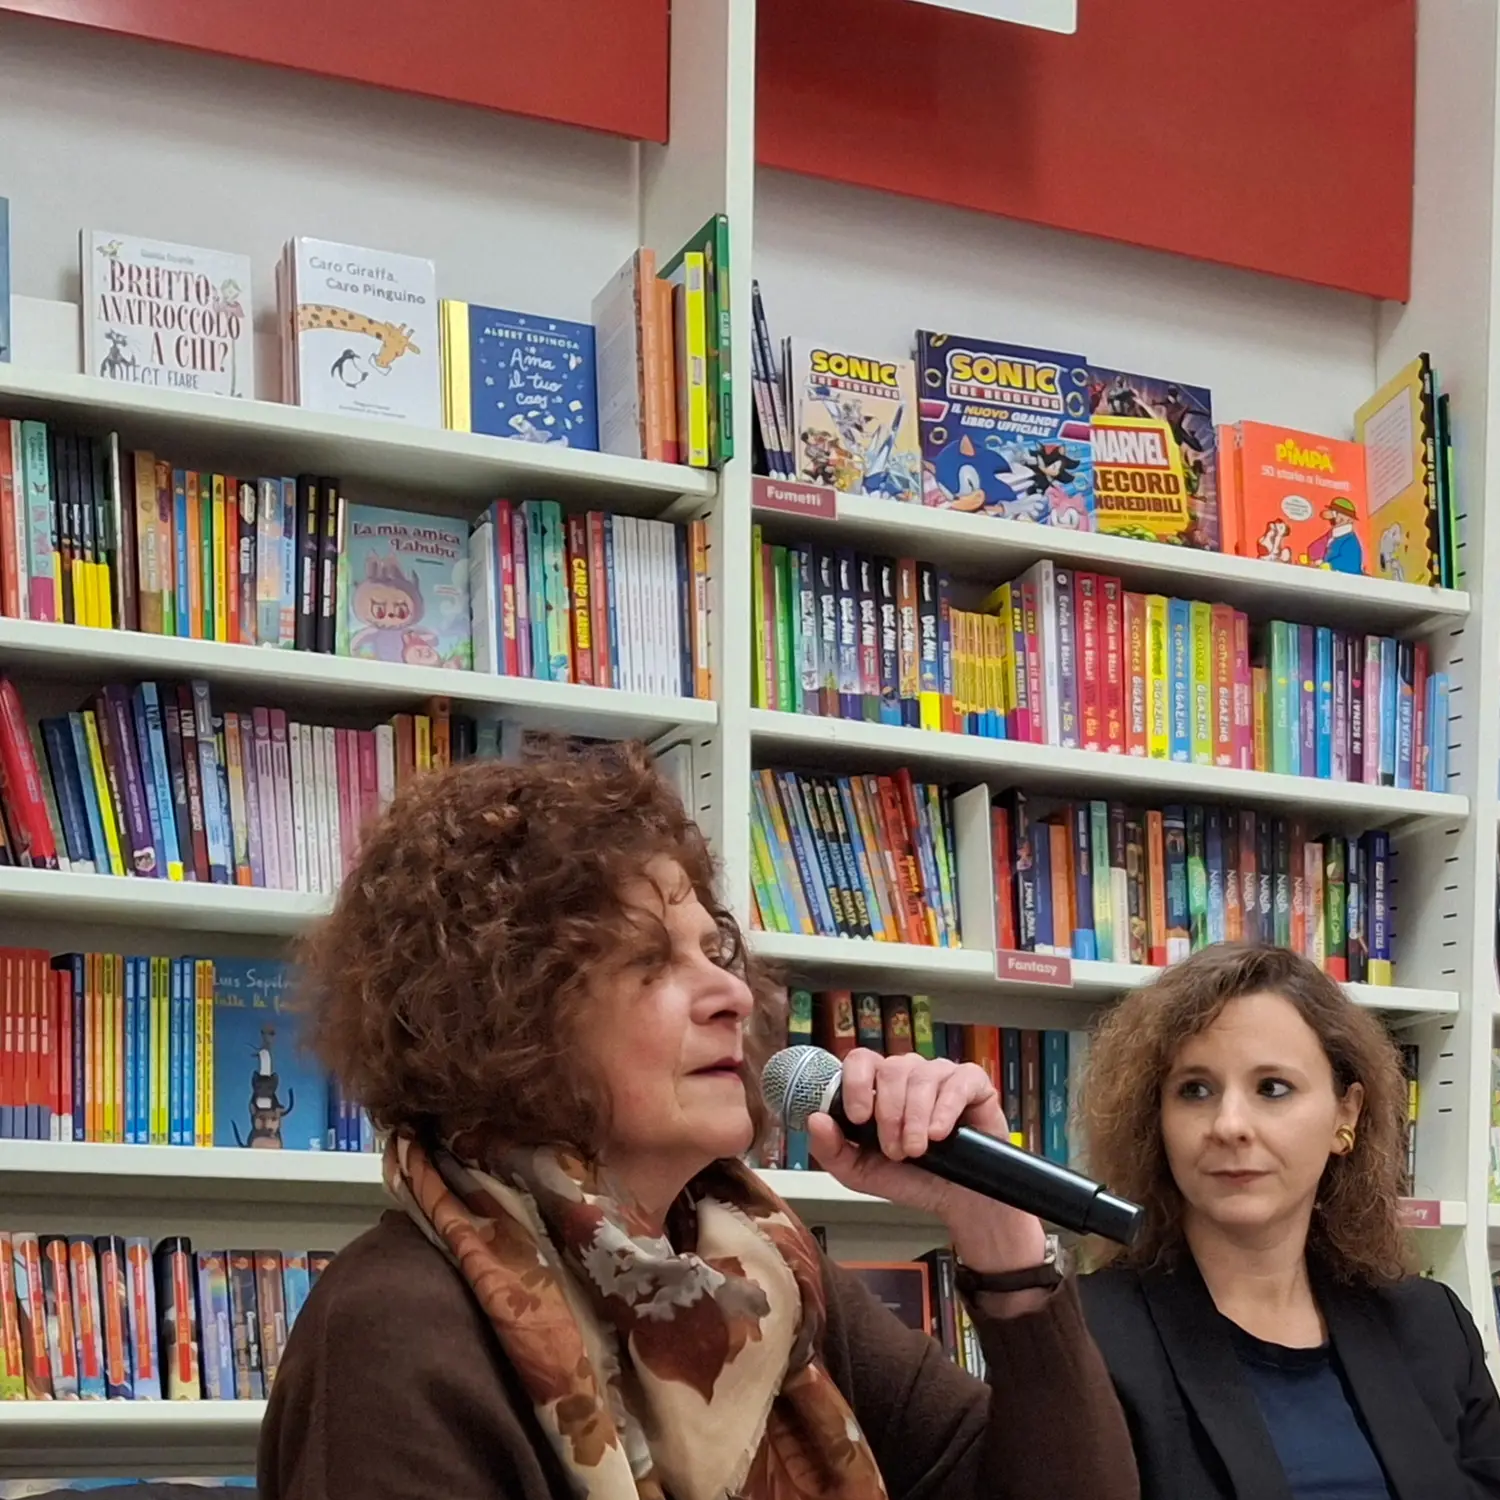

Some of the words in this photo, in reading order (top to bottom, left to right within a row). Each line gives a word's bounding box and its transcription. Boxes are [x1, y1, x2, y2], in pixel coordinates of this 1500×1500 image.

[309, 256, 344, 274] Caro
[109, 258, 211, 306] BRUTTO
[325, 277, 360, 295] Caro
[362, 283, 426, 306] Pinguino
[96, 293, 241, 340] ANATROCCOLO
[150, 331, 164, 366] A
[175, 335, 229, 373] CHI?
[484, 327, 524, 342] ALBERT
[526, 332, 580, 350] ESPINOSA
[510, 347, 556, 371] Ama
[809, 348, 899, 387] SONIC
[948, 352, 1058, 393] SONIC
[167, 370, 200, 391] FIABE
[508, 373, 525, 391] il
[526, 372, 563, 393] tuo
[951, 402, 963, 415] IL
[964, 404, 1009, 421] NUOVO
[1011, 412, 1059, 428] GRANDE
[960, 414, 996, 430] LIBRO
[997, 419, 1052, 438] UFFICIALE
[1091, 427, 1169, 467] MARVEL
[1274, 437, 1336, 473] PIMPA
[1093, 467, 1181, 496] RECORD
[1276, 467, 1303, 484] storie
[1315, 472, 1352, 492] fumetti
[766, 485, 822, 507] Fumetti
[1094, 494, 1181, 514] NCREDIBILI
[352, 520, 375, 538] La
[376, 523, 410, 541] mia
[411, 527, 461, 547] amica
[390, 536, 457, 560] Labubu
[145, 703, 161, 731] LYON
[180, 709, 196, 738] LYON
[1352, 699, 1362, 738] SCENA!
[1400, 700, 1412, 762] FANTASMI
[1352, 741, 1362, 755] IN
[1007, 956, 1058, 976] Fantasy
